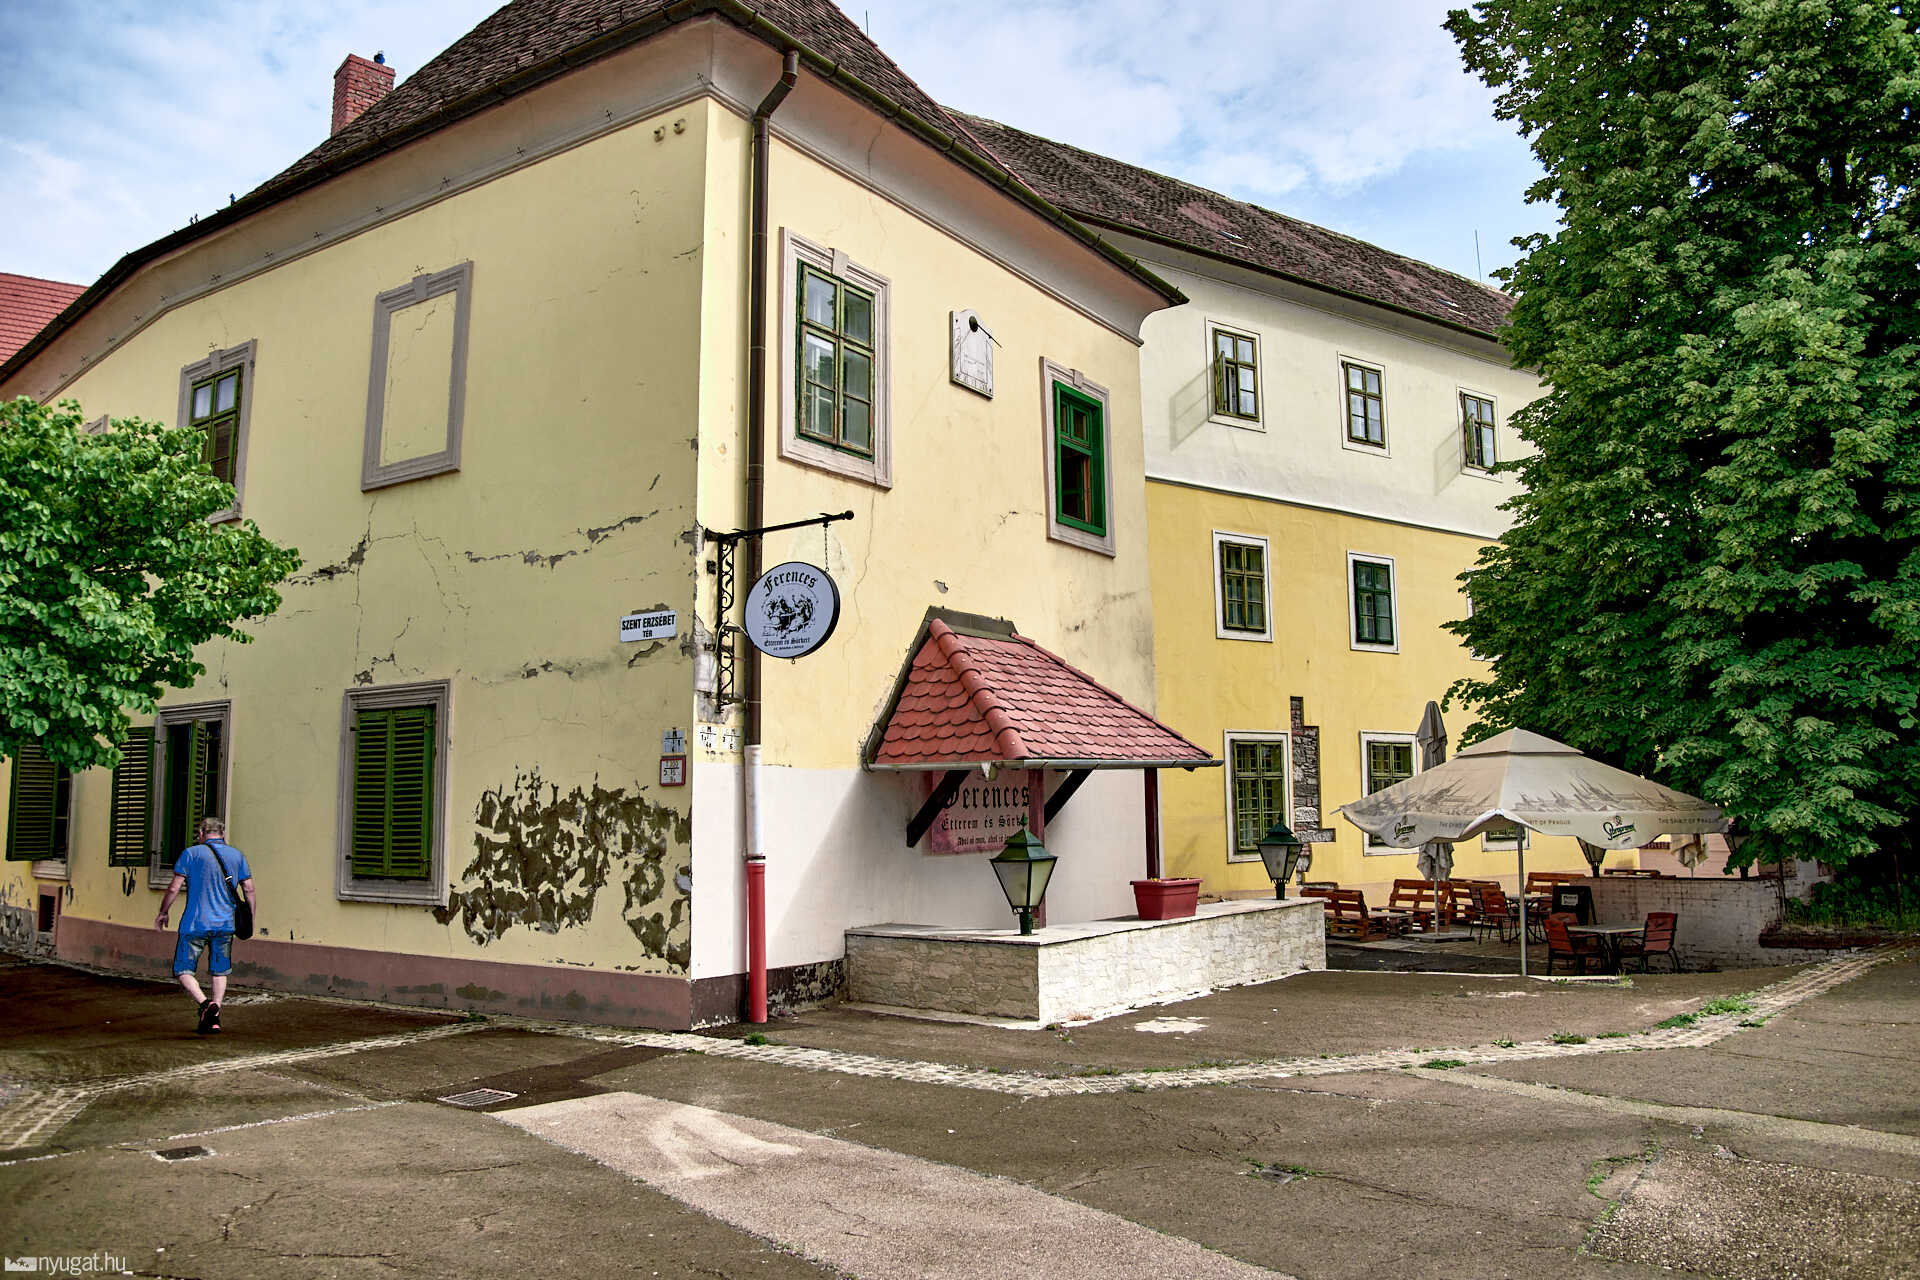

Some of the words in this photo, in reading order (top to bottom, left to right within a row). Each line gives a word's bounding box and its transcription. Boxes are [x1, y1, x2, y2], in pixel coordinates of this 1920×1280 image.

[763, 571, 817, 598] Ferences
[622, 619, 641, 630] SZENT
[643, 613, 675, 628] ERZSÉBET
[643, 630, 652, 638] TÉR
